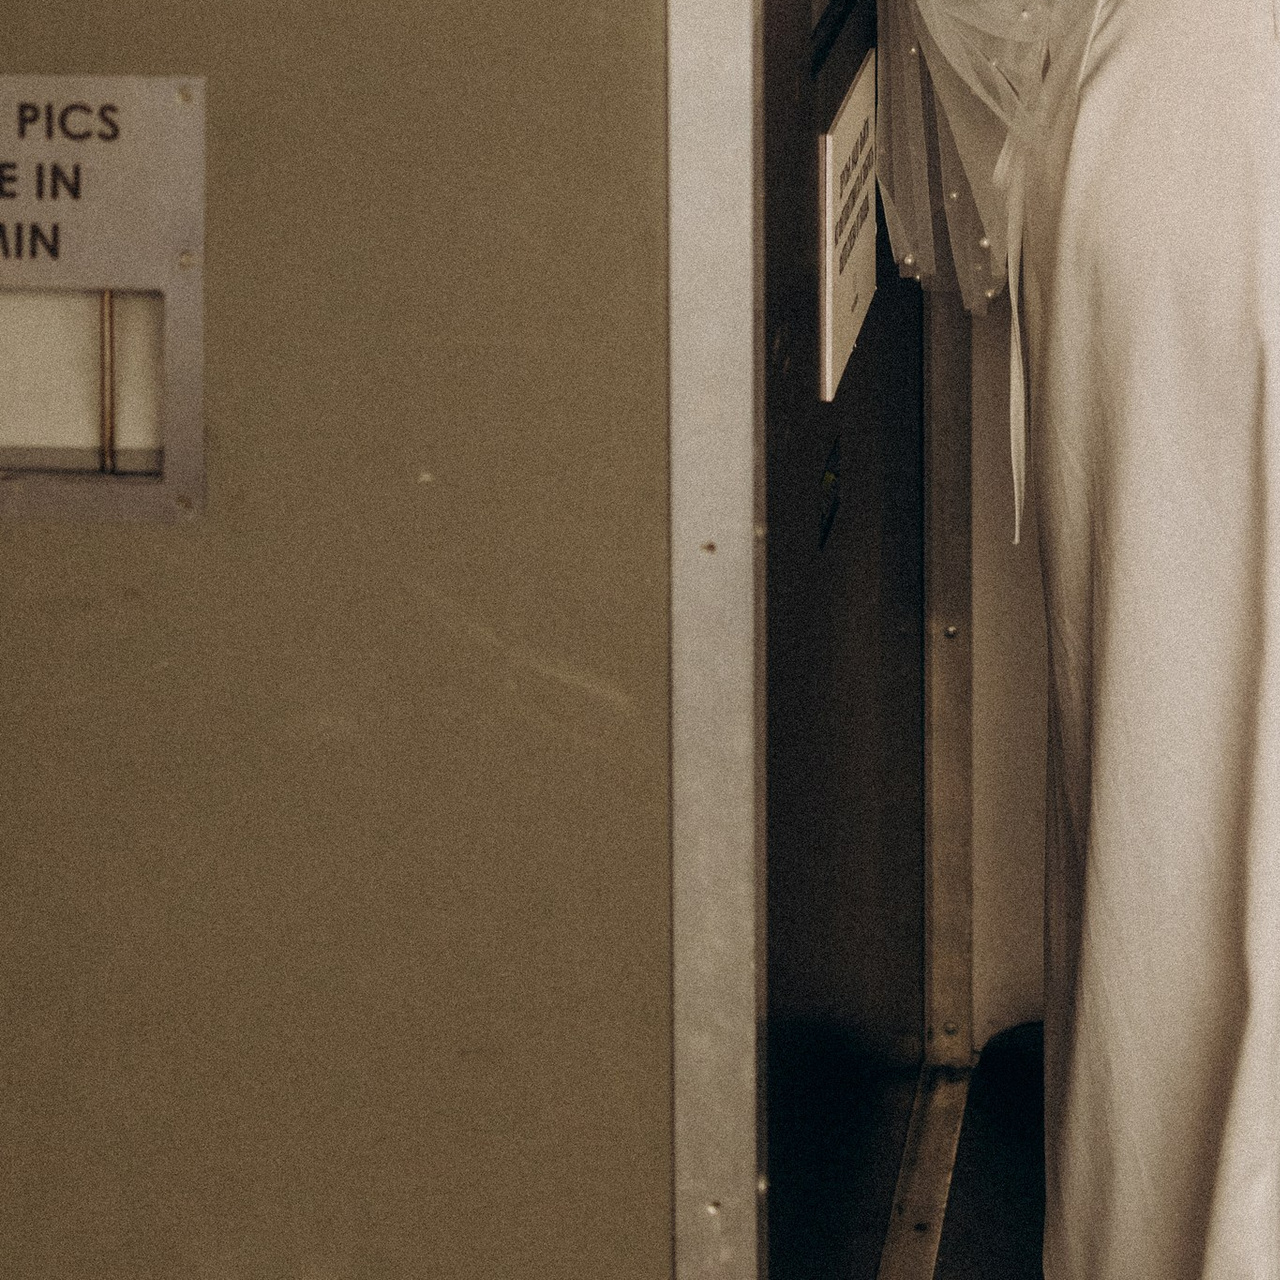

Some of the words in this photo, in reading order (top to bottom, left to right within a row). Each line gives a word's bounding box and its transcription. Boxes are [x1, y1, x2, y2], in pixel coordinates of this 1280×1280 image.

[16, 101, 121, 143] PICS
[35, 162, 82, 201] IN
[0, 222, 61, 260] IN
